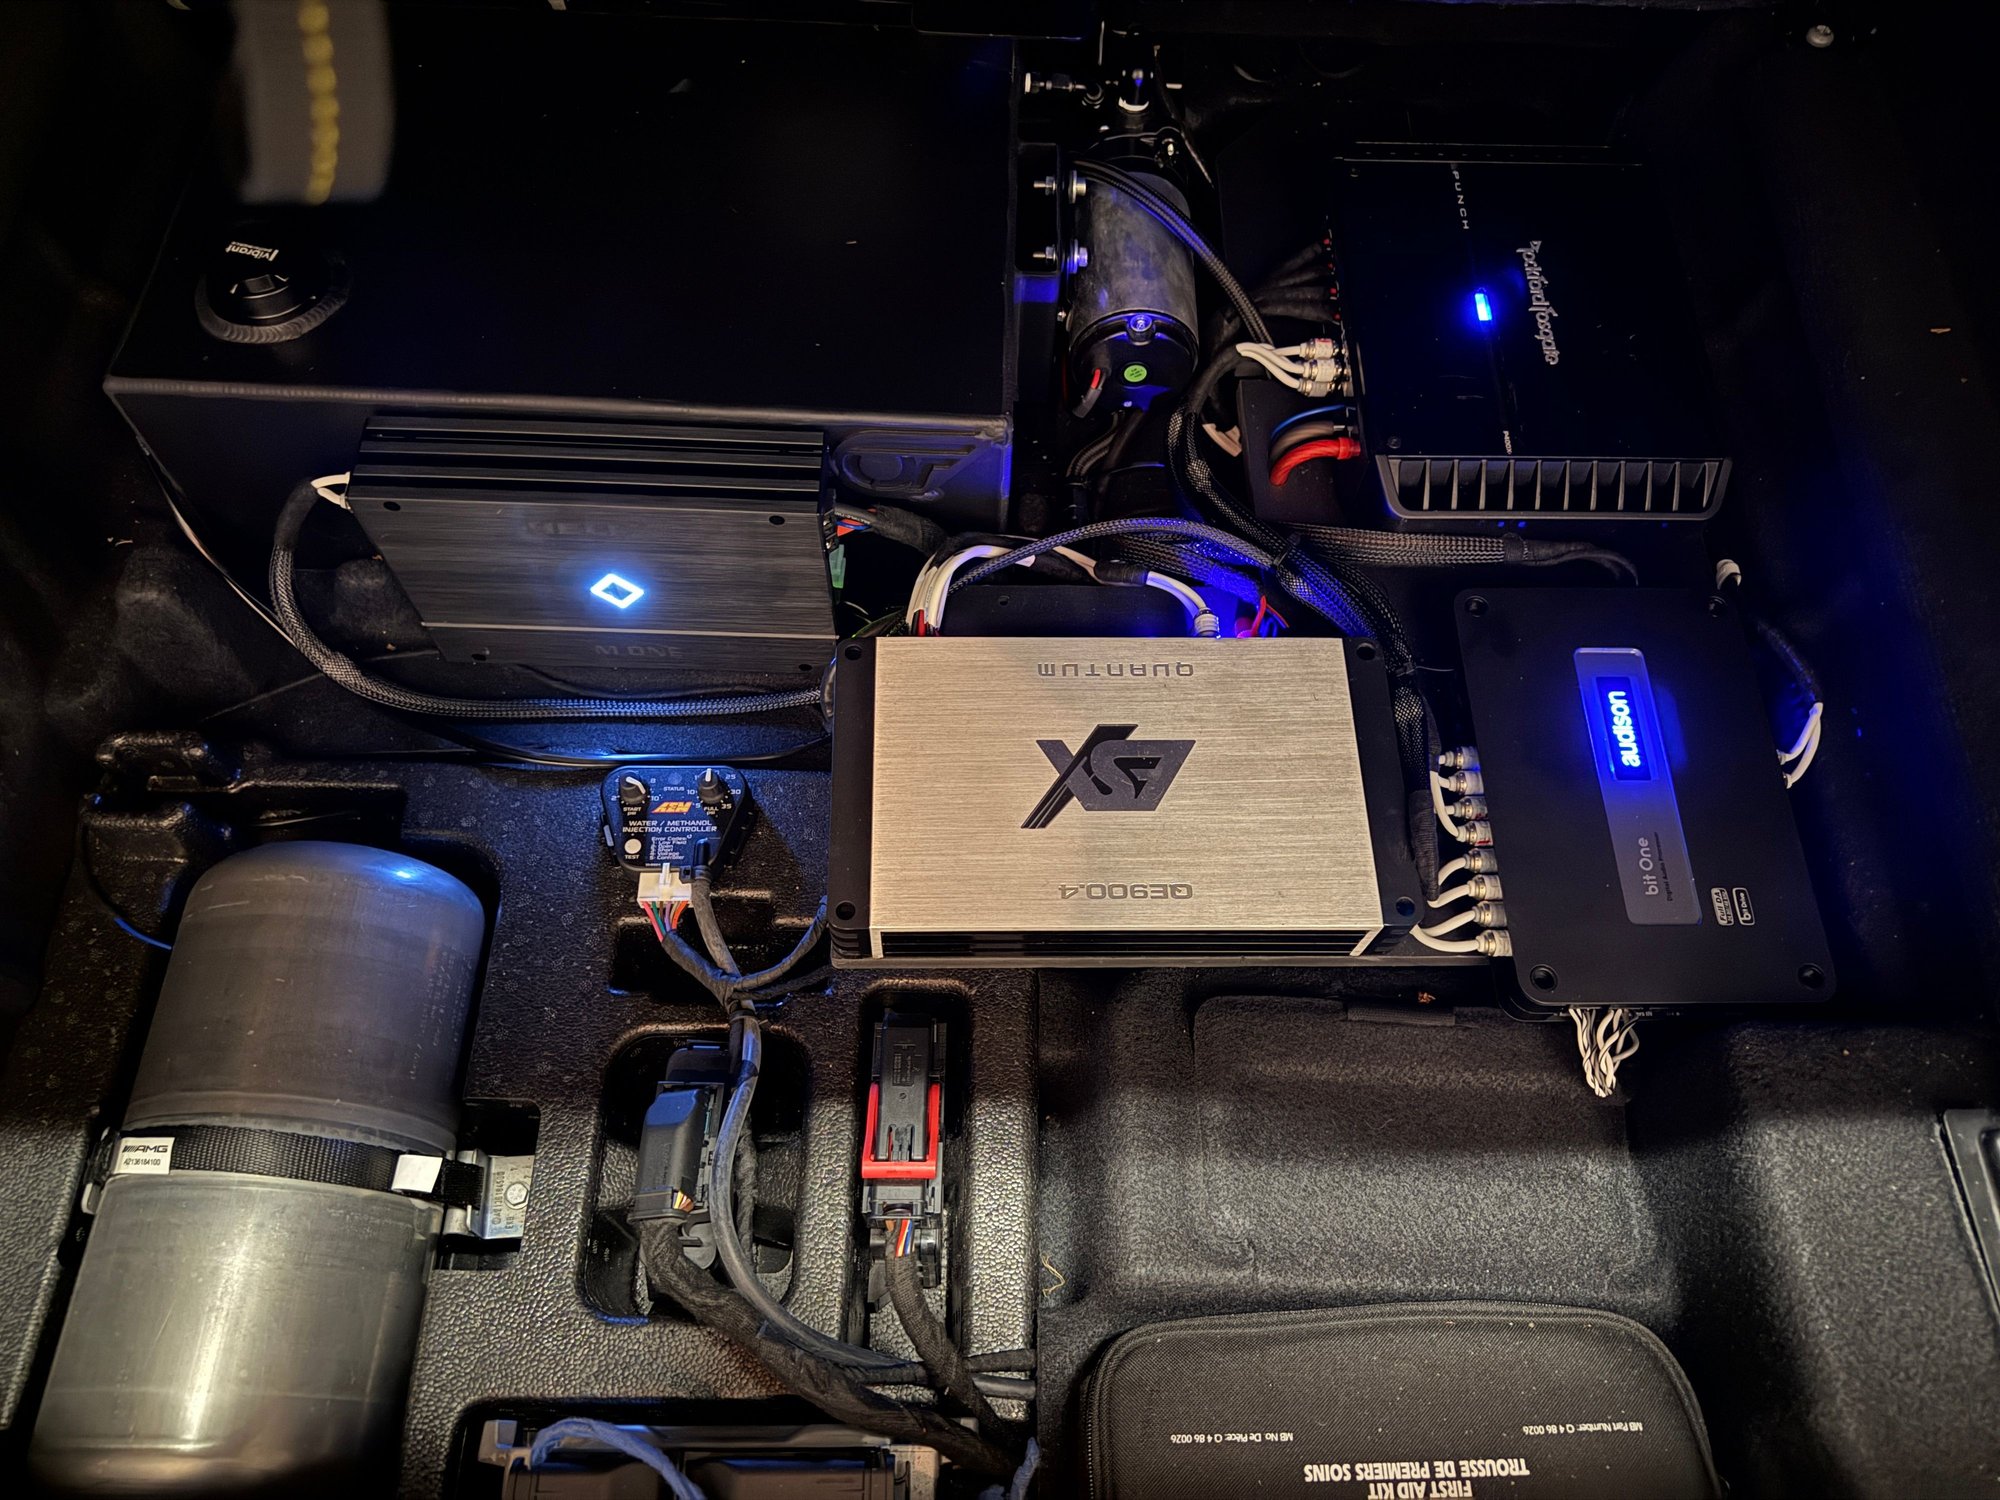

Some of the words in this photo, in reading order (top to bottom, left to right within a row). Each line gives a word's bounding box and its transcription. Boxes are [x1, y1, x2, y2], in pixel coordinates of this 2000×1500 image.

[1452, 170, 1470, 230] PUNCH
[224, 244, 271, 260] vibrant
[595, 645, 620, 656] M
[627, 646, 684, 658] ONE
[1038, 662, 1194, 677] QUANTUM
[1608, 691, 1642, 768] audison
[1020, 724, 1197, 829] ESX
[1638, 838, 1654, 871] One
[1058, 882, 1194, 900] QE900.4
[1642, 874, 1660, 896] bit
[1714, 892, 1722, 903] DA
[1717, 906, 1726, 922] Full
[1522, 1424, 1545, 1435] 0026
[1546, 1424, 1558, 1434] 86
[1559, 1424, 1565, 1434] 4
[1612, 1422, 1629, 1431] Part
[1629, 1422, 1643, 1431] MB
[1170, 1434, 1192, 1443] 0026
[1194, 1434, 1205, 1443] 86
[1206, 1434, 1213, 1443] 4
[1249, 1433, 1262, 1442] De
[1280, 1432, 1294, 1441] MB
[1304, 1463, 1351, 1482] SOINS
[1355, 1461, 1430, 1481] PREMIERS
[1434, 1461, 1457, 1478] DE
[1459, 1458, 1530, 1478] TROUSSE
[1368, 1482, 1394, 1500] KIT
[1396, 1482, 1426, 1499] AID
[1430, 1480, 1473, 1498] FIRST
